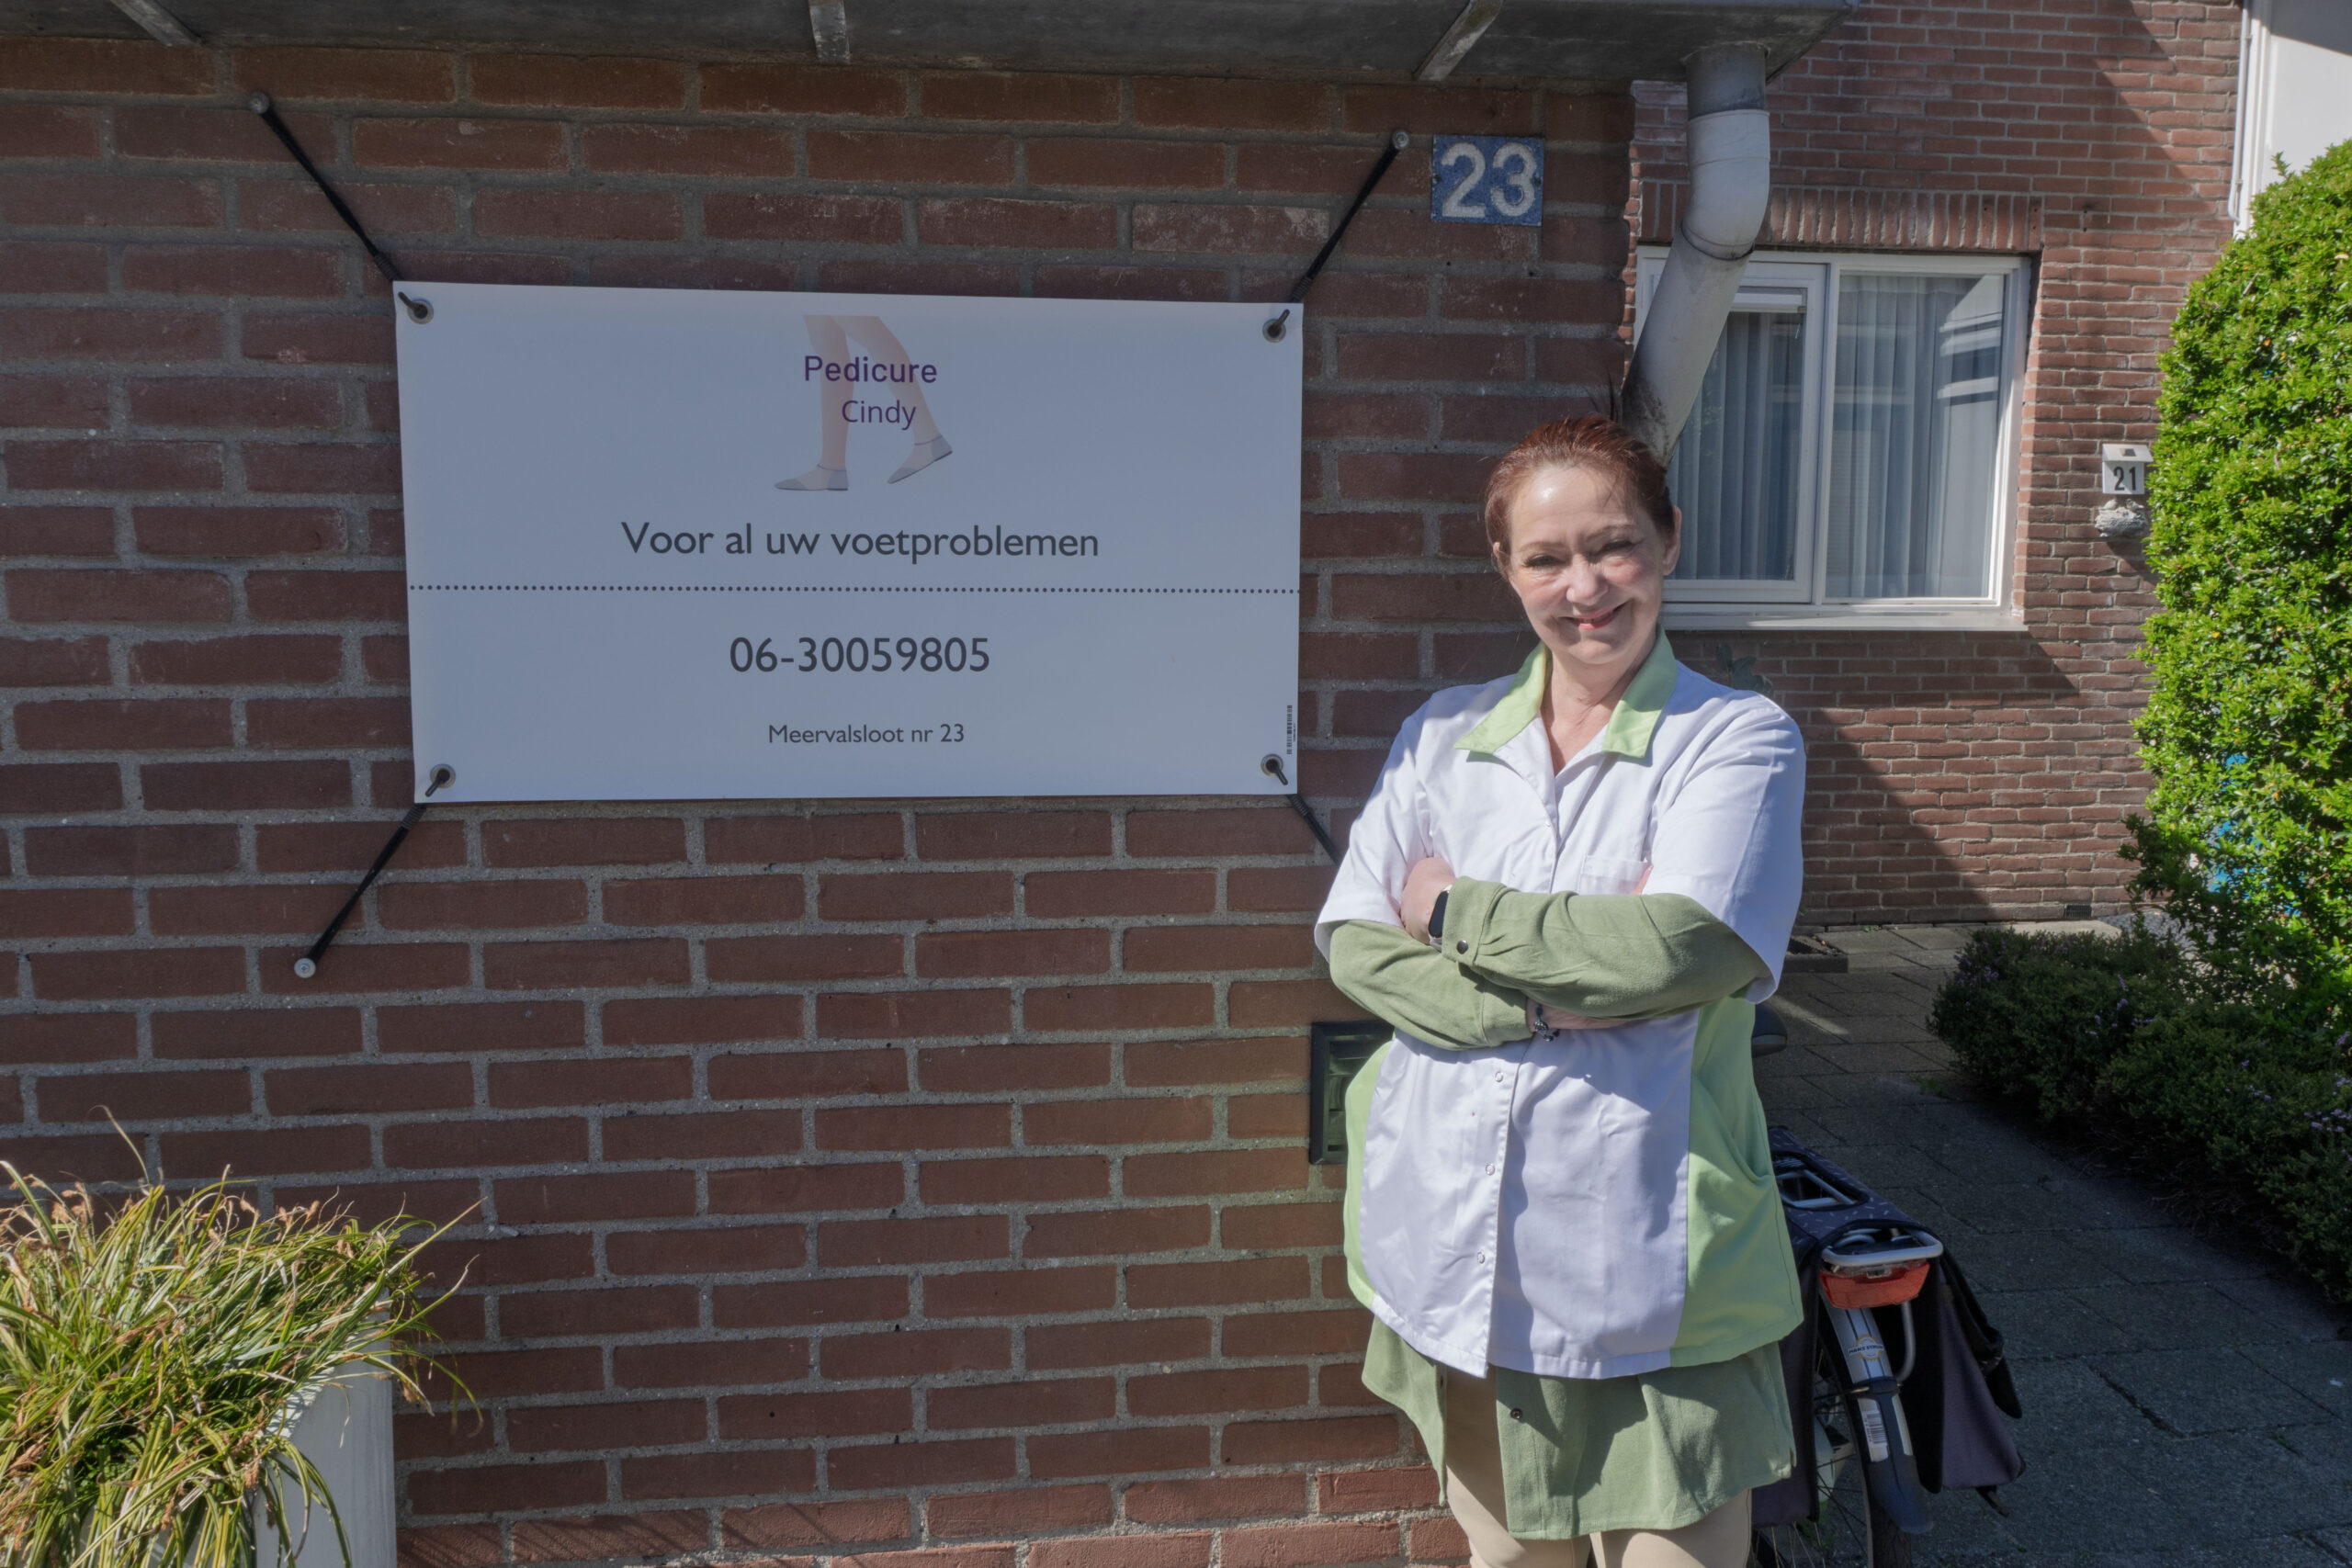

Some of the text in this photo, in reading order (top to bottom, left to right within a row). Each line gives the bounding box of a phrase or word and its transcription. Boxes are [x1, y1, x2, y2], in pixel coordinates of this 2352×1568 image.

[1441, 141, 1537, 219] 23
[804, 355, 937, 384] Pedicure
[841, 399, 918, 431] Cindy
[2113, 466, 2137, 491] 21
[620, 521, 1099, 565] Voor al uw voetproblemen
[729, 637, 989, 673] 06-30059805
[768, 723, 965, 744] Meervalsloot nr 23
